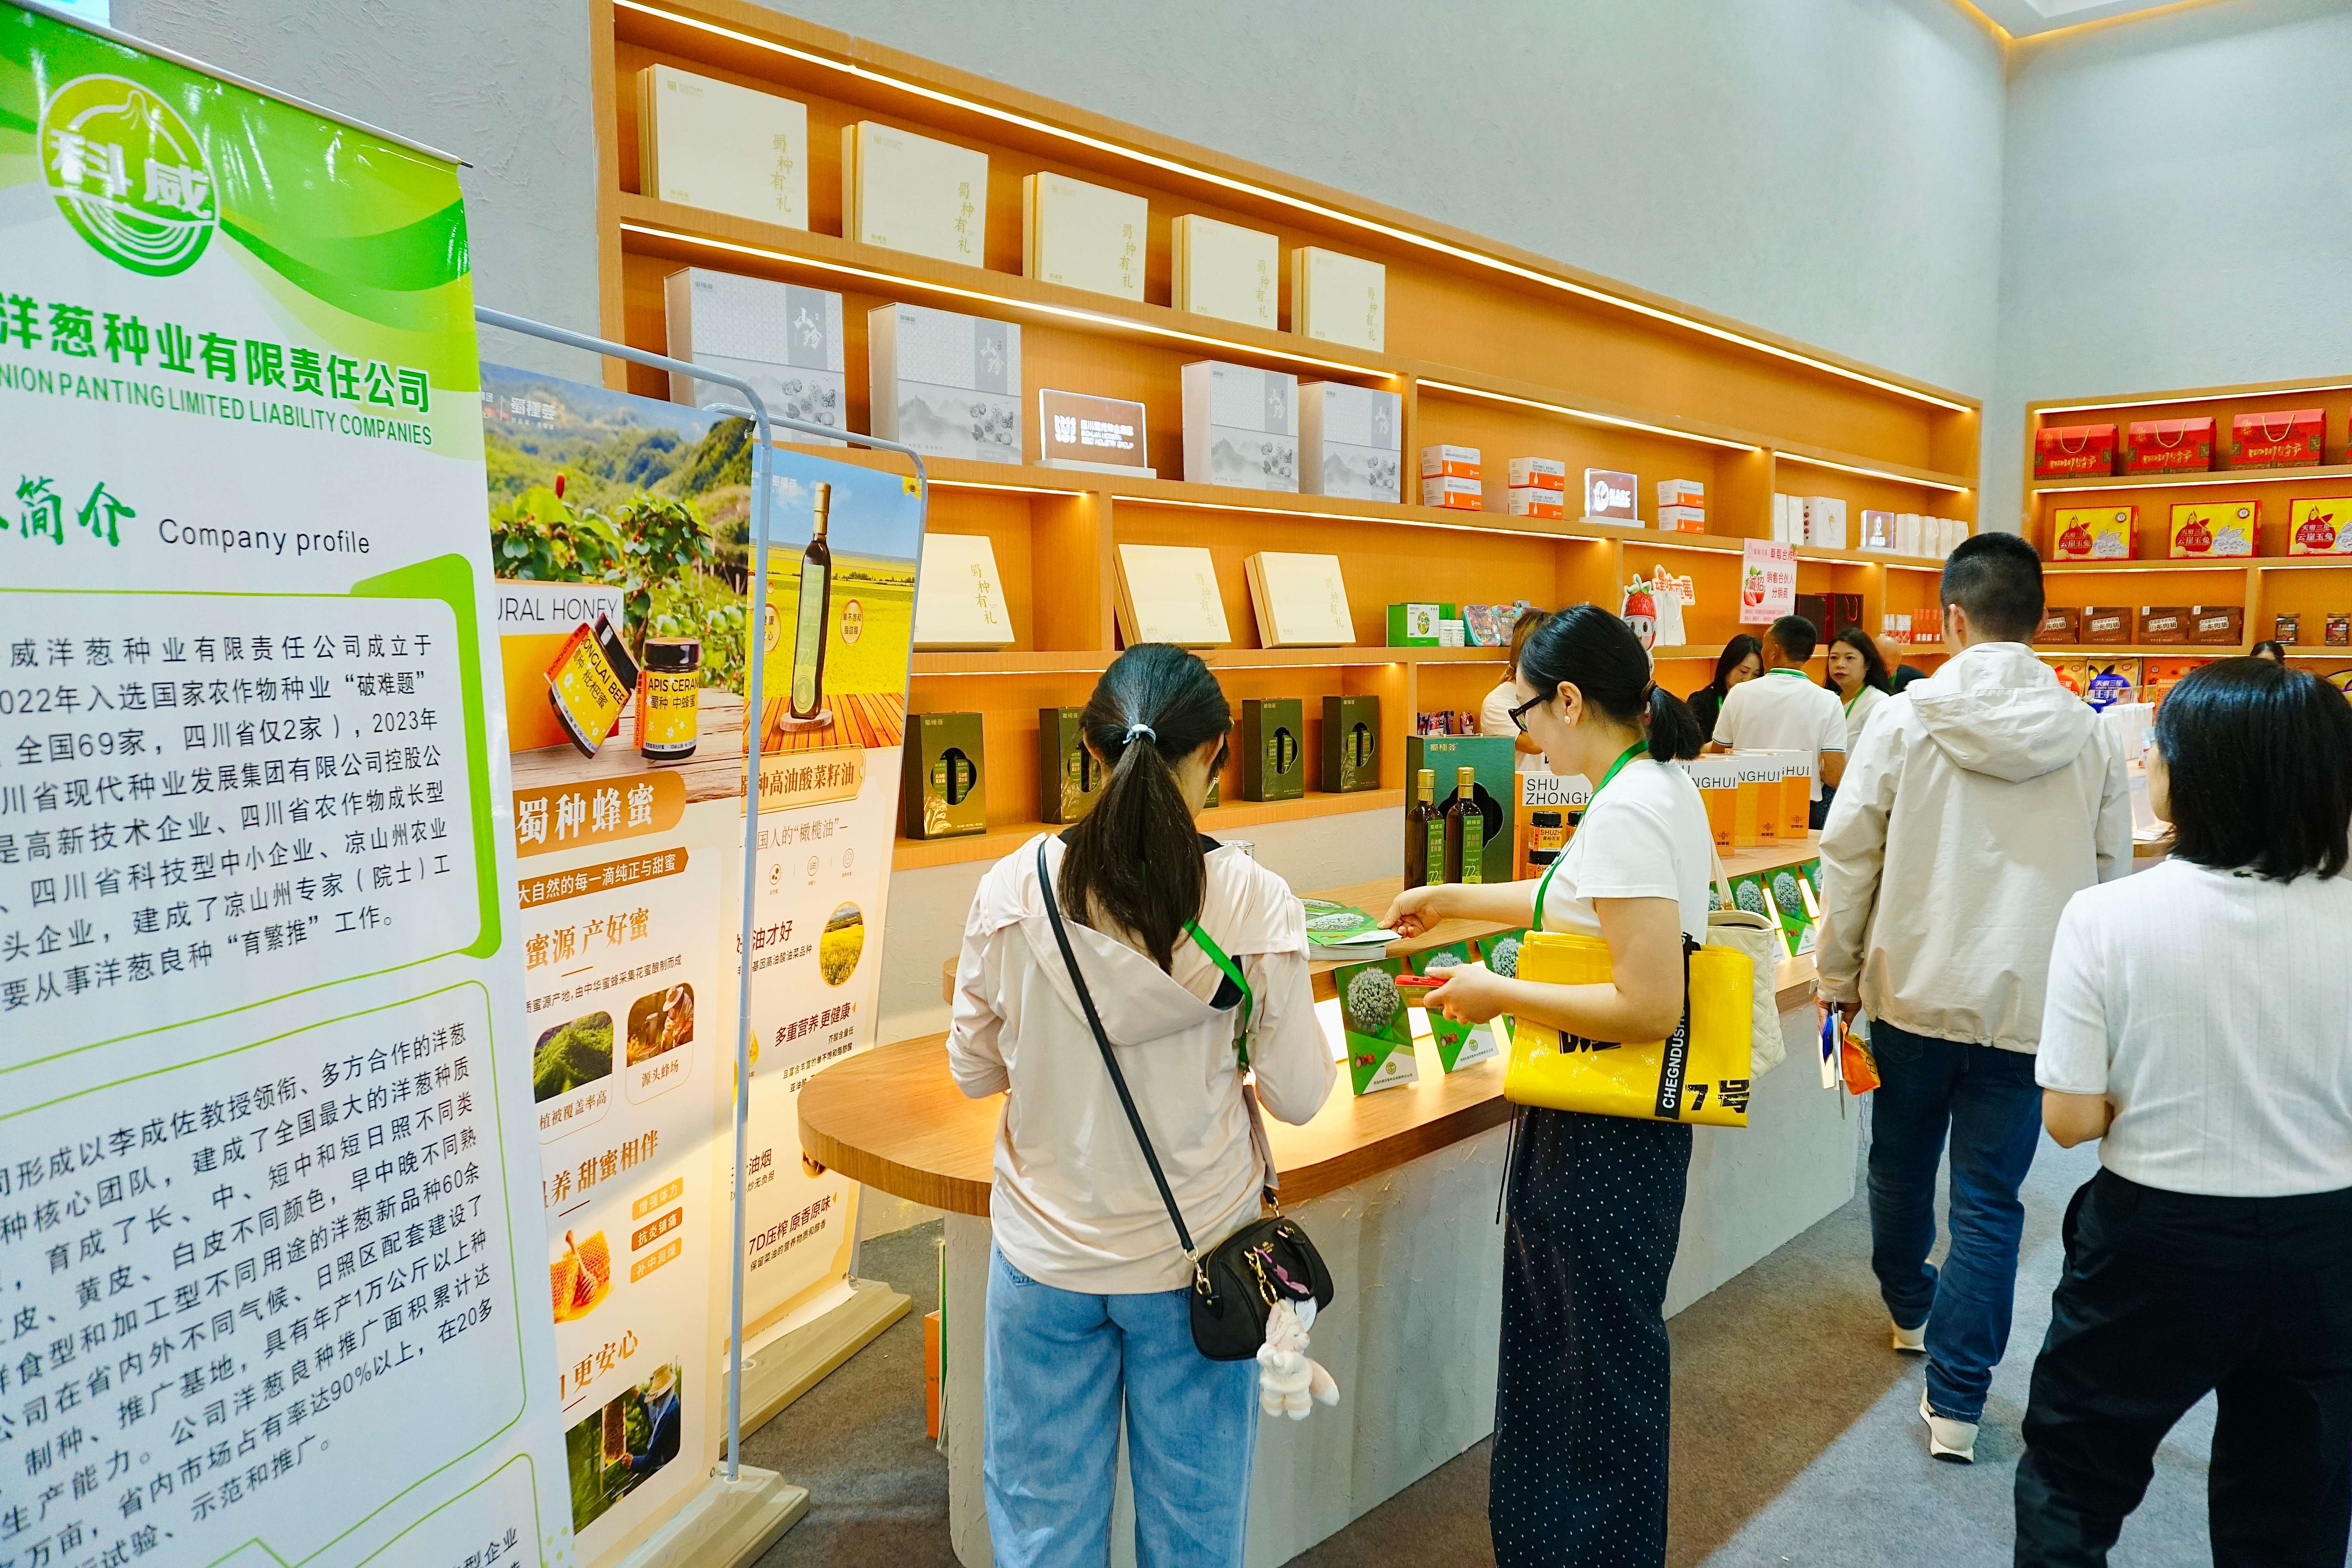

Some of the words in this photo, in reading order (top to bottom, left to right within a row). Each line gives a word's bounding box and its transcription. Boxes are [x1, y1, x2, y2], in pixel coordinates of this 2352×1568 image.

[50, 128, 212, 219] 科威
[771, 133, 794, 213] 蜀种有礼
[954, 182, 974, 254] 蜀种有礼
[1119, 223, 1136, 288] 蜀种有礼
[59, 373, 164, 408] PANTING
[169, 388, 244, 420] LIMITED
[250, 399, 336, 432] LIABILITY
[341, 414, 432, 446] COMPANIES
[159, 518, 286, 555] Company
[296, 528, 370, 556] profile
[1770, 547, 1794, 561] 草莓合作
[970, 564, 997, 624] 蜀种有礼
[1749, 575, 1764, 592] 诚招
[1767, 572, 1794, 585] 销售合伙人
[1772, 587, 1789, 599] 分销商
[553, 598, 618, 621] HONEY
[843, 612, 861, 622] 单不饱和
[844, 625, 858, 635] 脂肪酸
[11, 633, 431, 668] 威洋葱种业有限责任公司成立于
[648, 678, 668, 692] APIS
[652, 695, 668, 710] 蜀种
[673, 694, 696, 710] 中蜂蜜
[2, 745, 441, 815] 川省现代种业发展集团有限公司控股公
[1527, 778, 1559, 791] SHU
[1739, 771, 1780, 782] NGHUI
[1782, 766, 1809, 776] HUI
[515, 783, 654, 845] 蜀种蜂蜜
[518, 853, 676, 903] 大自然的每一滴纯正与甜蜜
[525, 925, 576, 970] 蜜源
[581, 907, 649, 955] 产好蜜
[775, 1014, 818, 1047] 多重营养
[820, 1002, 851, 1029] 更健康
[828, 1025, 854, 1044] 芥酸含量低
[642, 1059, 679, 1088] 源头蜂场
[539, 1089, 607, 1131] 植被覆盖率高
[543, 1170, 571, 1209] 养
[577, 1130, 659, 1193] 甜蜜相伴
[747, 1148, 772, 1176] 油烟
[639, 1183, 678, 1214] 增强体力
[638, 1212, 677, 1246] 抗炎镇痛
[749, 1219, 788, 1256] 7D压榨
[789, 1195, 831, 1233] 原香原味
[637, 1243, 677, 1278] 补中润燥
[750, 1219, 826, 1273] 保留菜油的营养物质和醇香
[574, 1330, 638, 1395] 更安心
